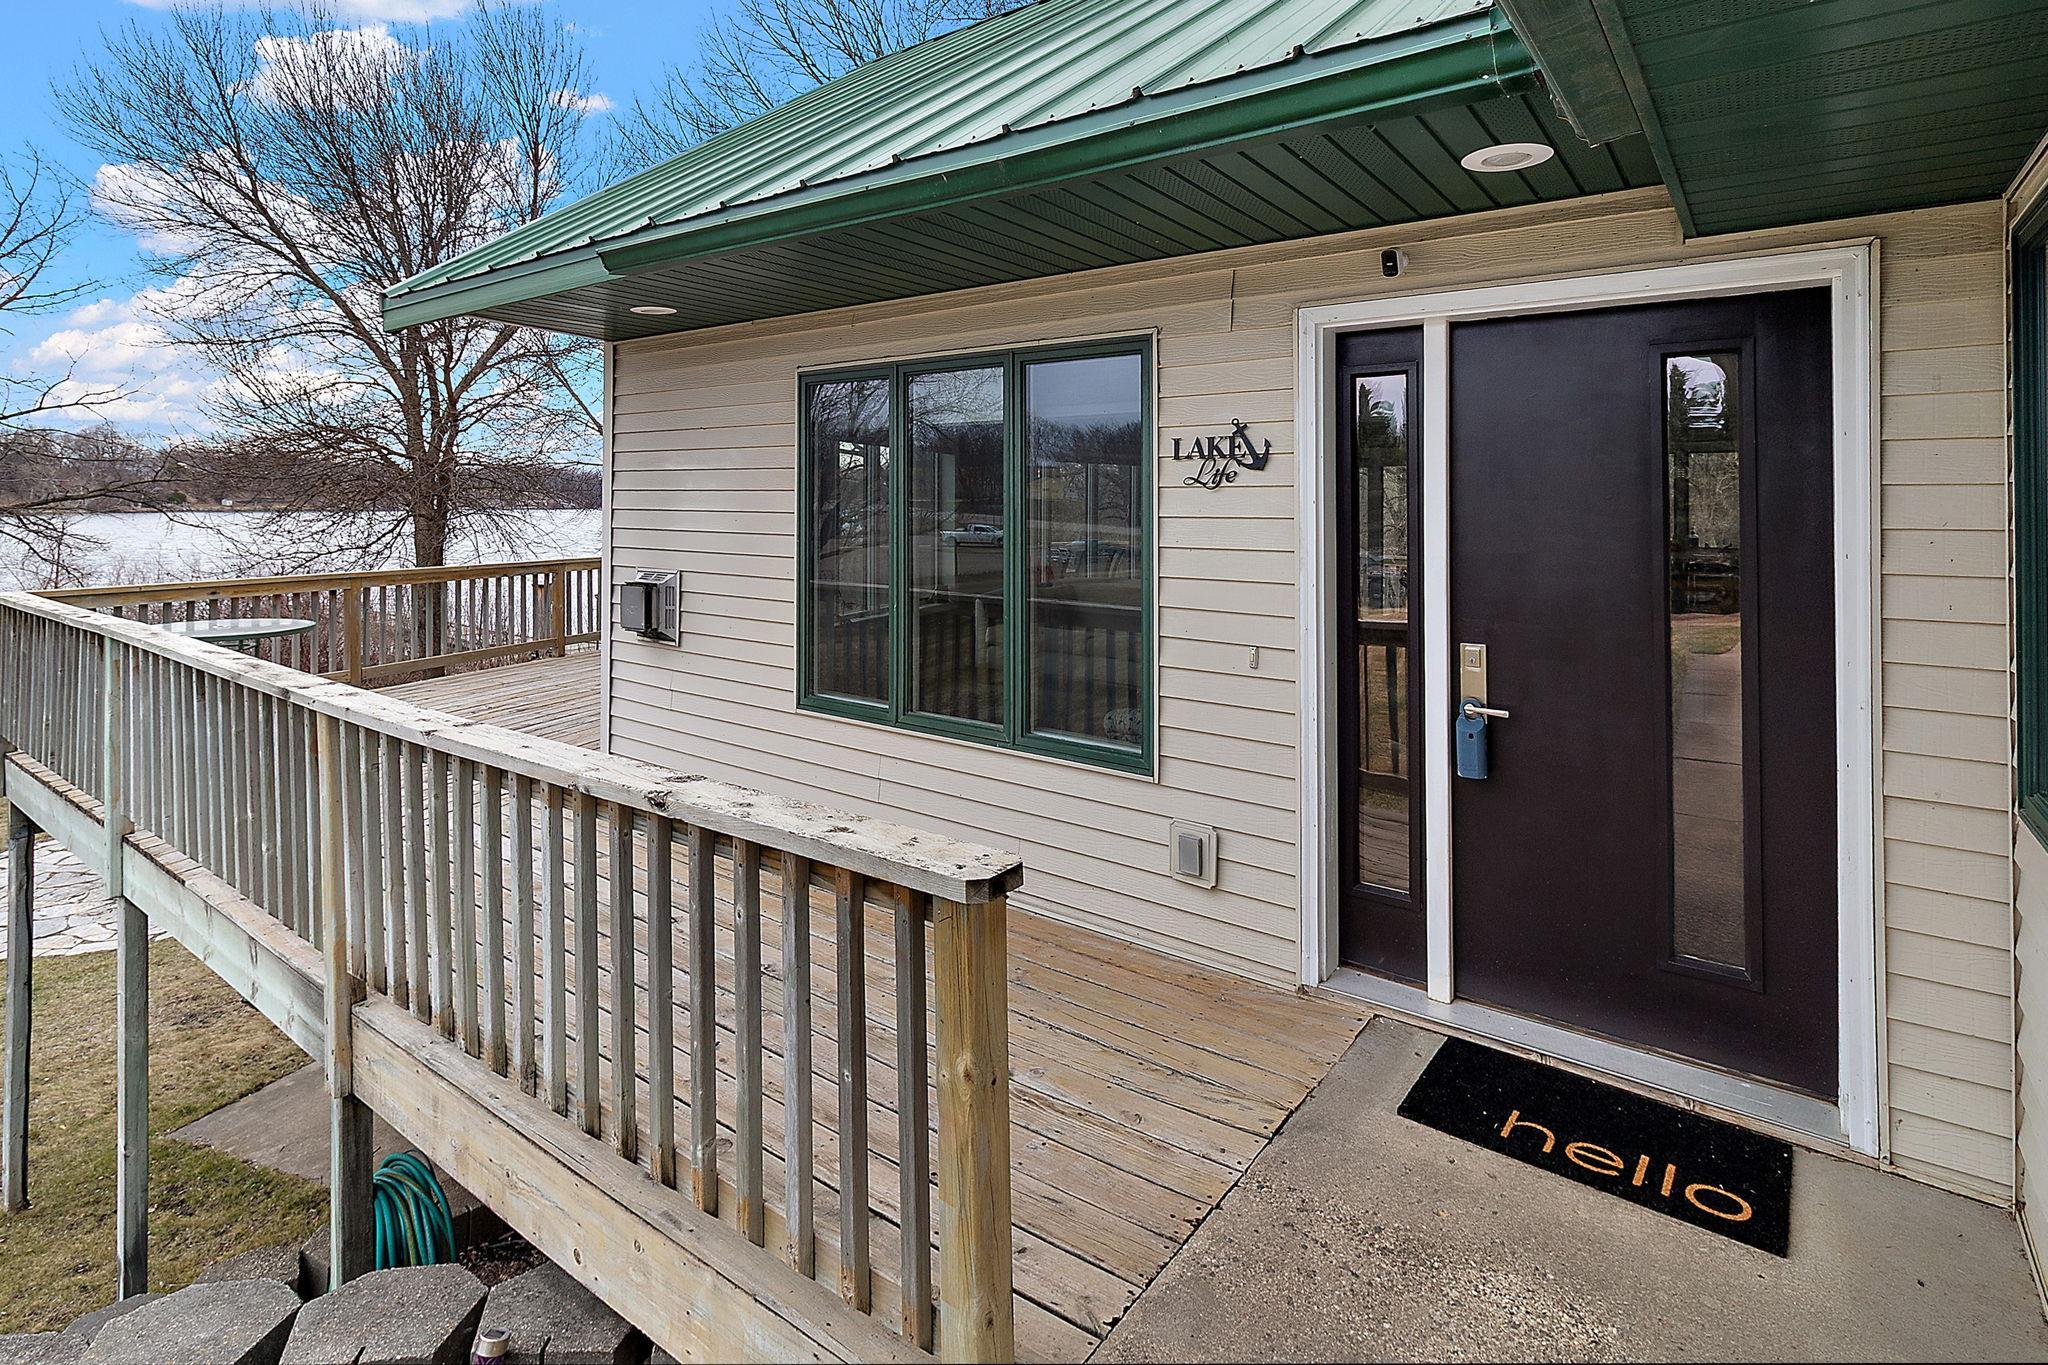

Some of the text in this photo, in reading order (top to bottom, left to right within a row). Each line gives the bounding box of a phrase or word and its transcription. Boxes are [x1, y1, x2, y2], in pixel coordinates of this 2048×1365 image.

[1171, 435, 1247, 460] LAKE
[1182, 457, 1238, 490] Life
[1500, 1110, 1753, 1222] hello
